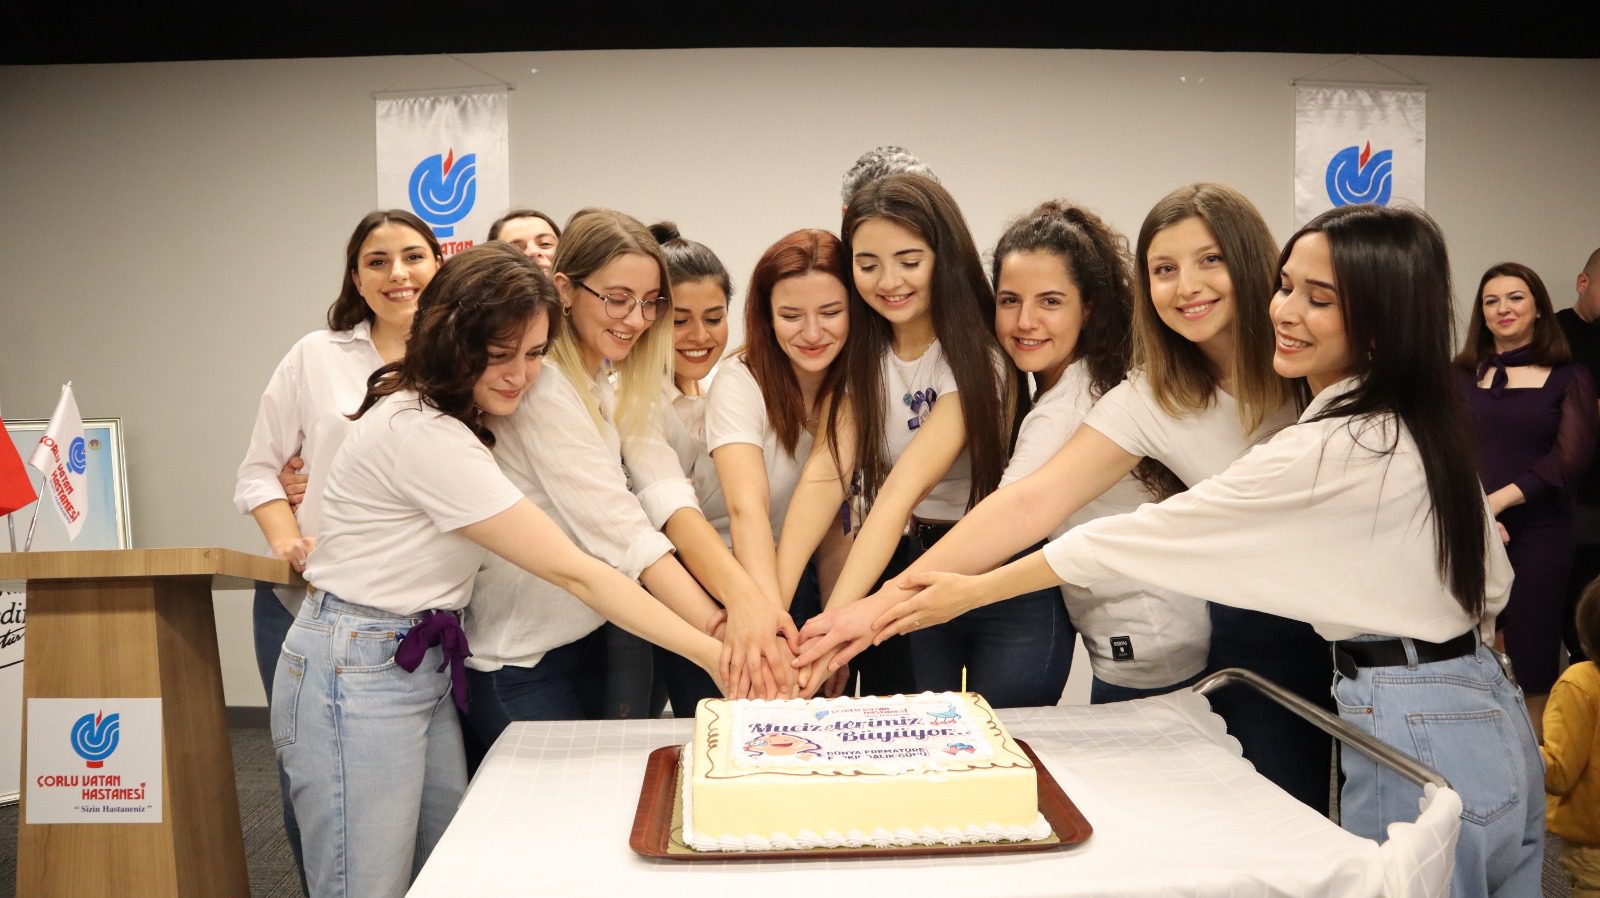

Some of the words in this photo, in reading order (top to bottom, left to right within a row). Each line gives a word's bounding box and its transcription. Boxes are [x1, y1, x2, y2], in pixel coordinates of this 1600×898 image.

[441, 240, 474, 256] ATAN
[57, 463, 75, 496] VATAN
[51, 470, 80, 522] HASTANESİ
[37, 775, 79, 788] ÇORLU
[82, 775, 121, 787] VATAN
[82, 782, 146, 800] HASTANESİ
[81, 805, 101, 813] Sizin
[103, 805, 146, 813] Hastaneniz
